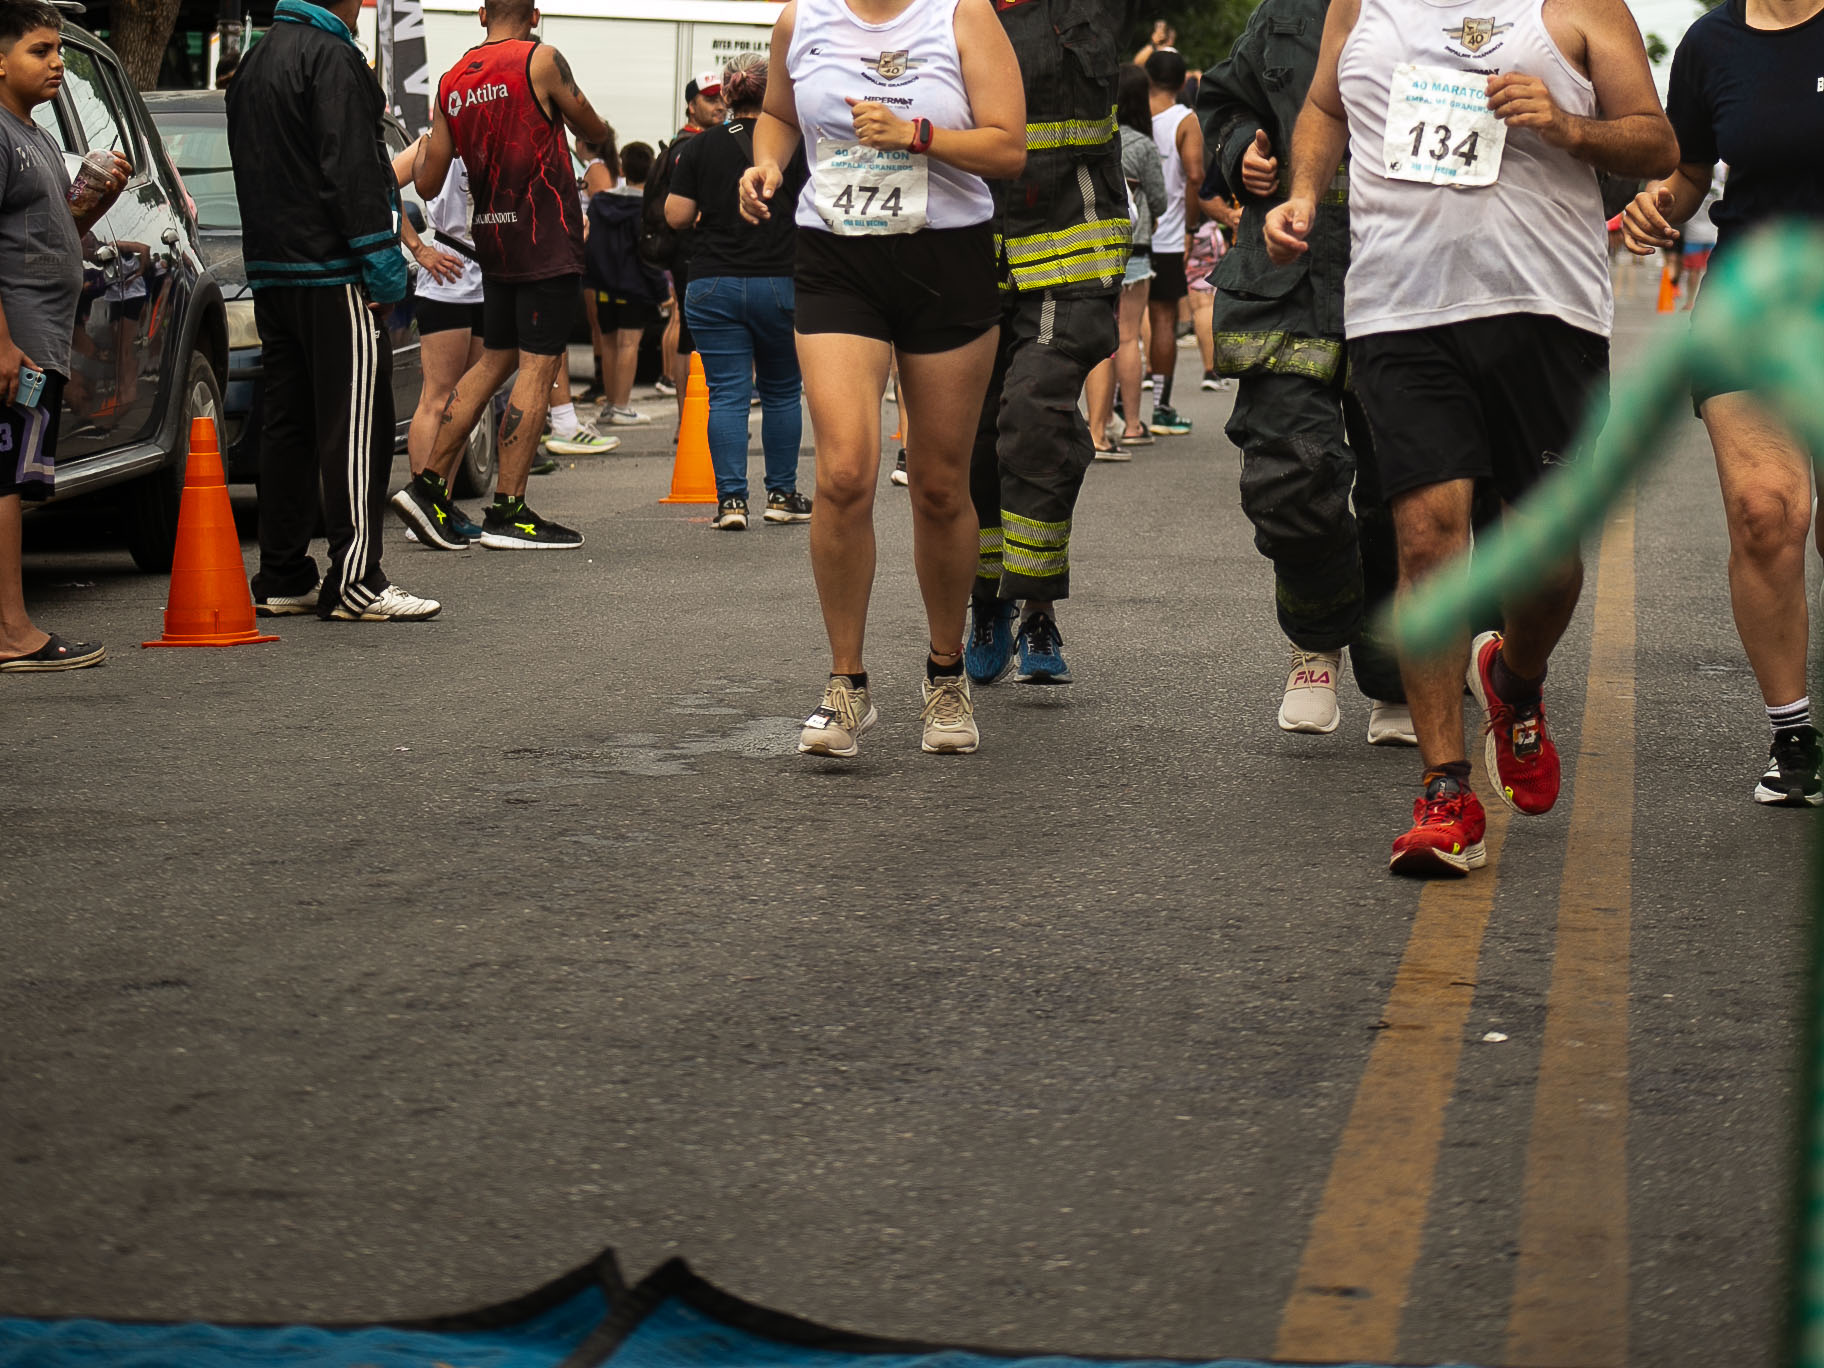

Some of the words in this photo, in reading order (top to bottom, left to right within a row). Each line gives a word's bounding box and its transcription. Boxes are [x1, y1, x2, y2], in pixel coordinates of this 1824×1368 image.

[1467, 34, 1485, 46] 40
[1412, 80, 1428, 91] 40
[465, 83, 509, 107] Atilra
[1408, 121, 1480, 168] 134
[834, 148, 849, 157] 40
[876, 150, 910, 161] ATON
[832, 184, 903, 217] 474
[1293, 670, 1330, 685] FILA
